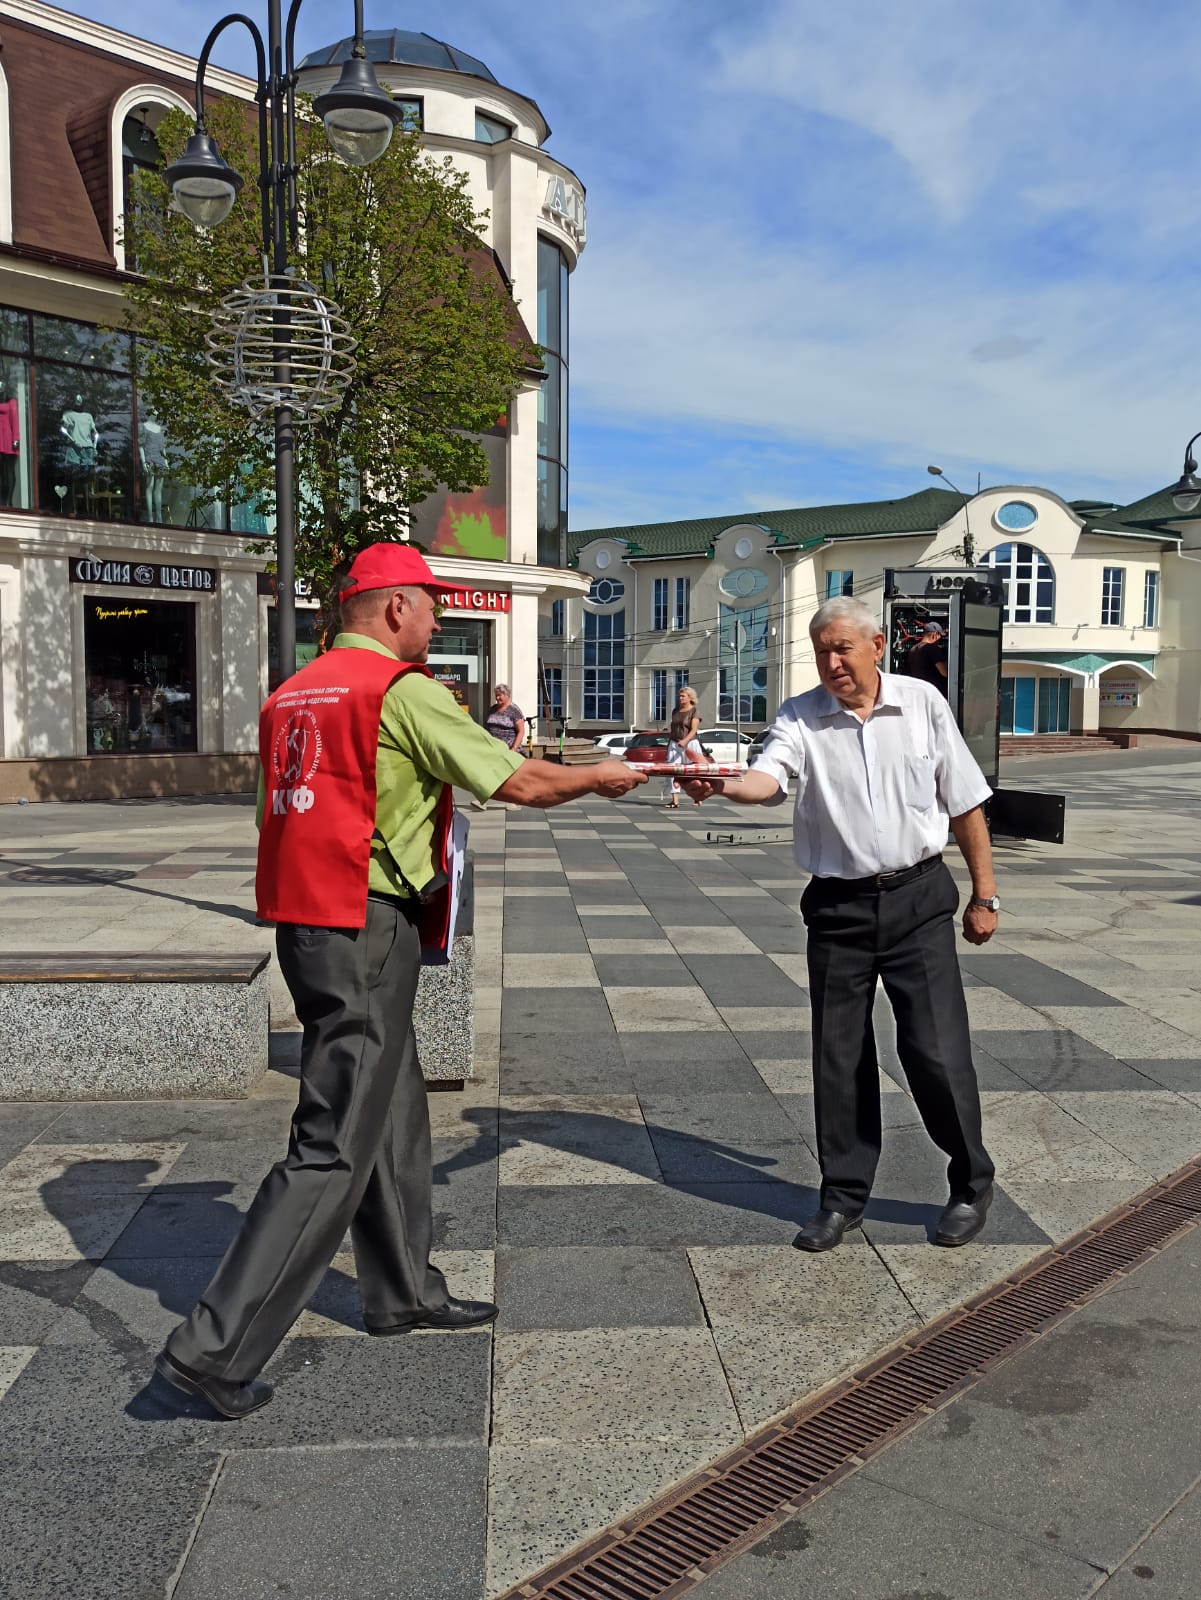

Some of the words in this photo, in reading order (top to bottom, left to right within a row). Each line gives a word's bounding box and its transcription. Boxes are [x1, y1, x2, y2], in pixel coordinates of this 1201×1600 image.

[76, 560, 130, 583] СТУДИЯ
[160, 567, 212, 589] ЦВЕТОВ
[441, 591, 507, 608] NLIGHT
